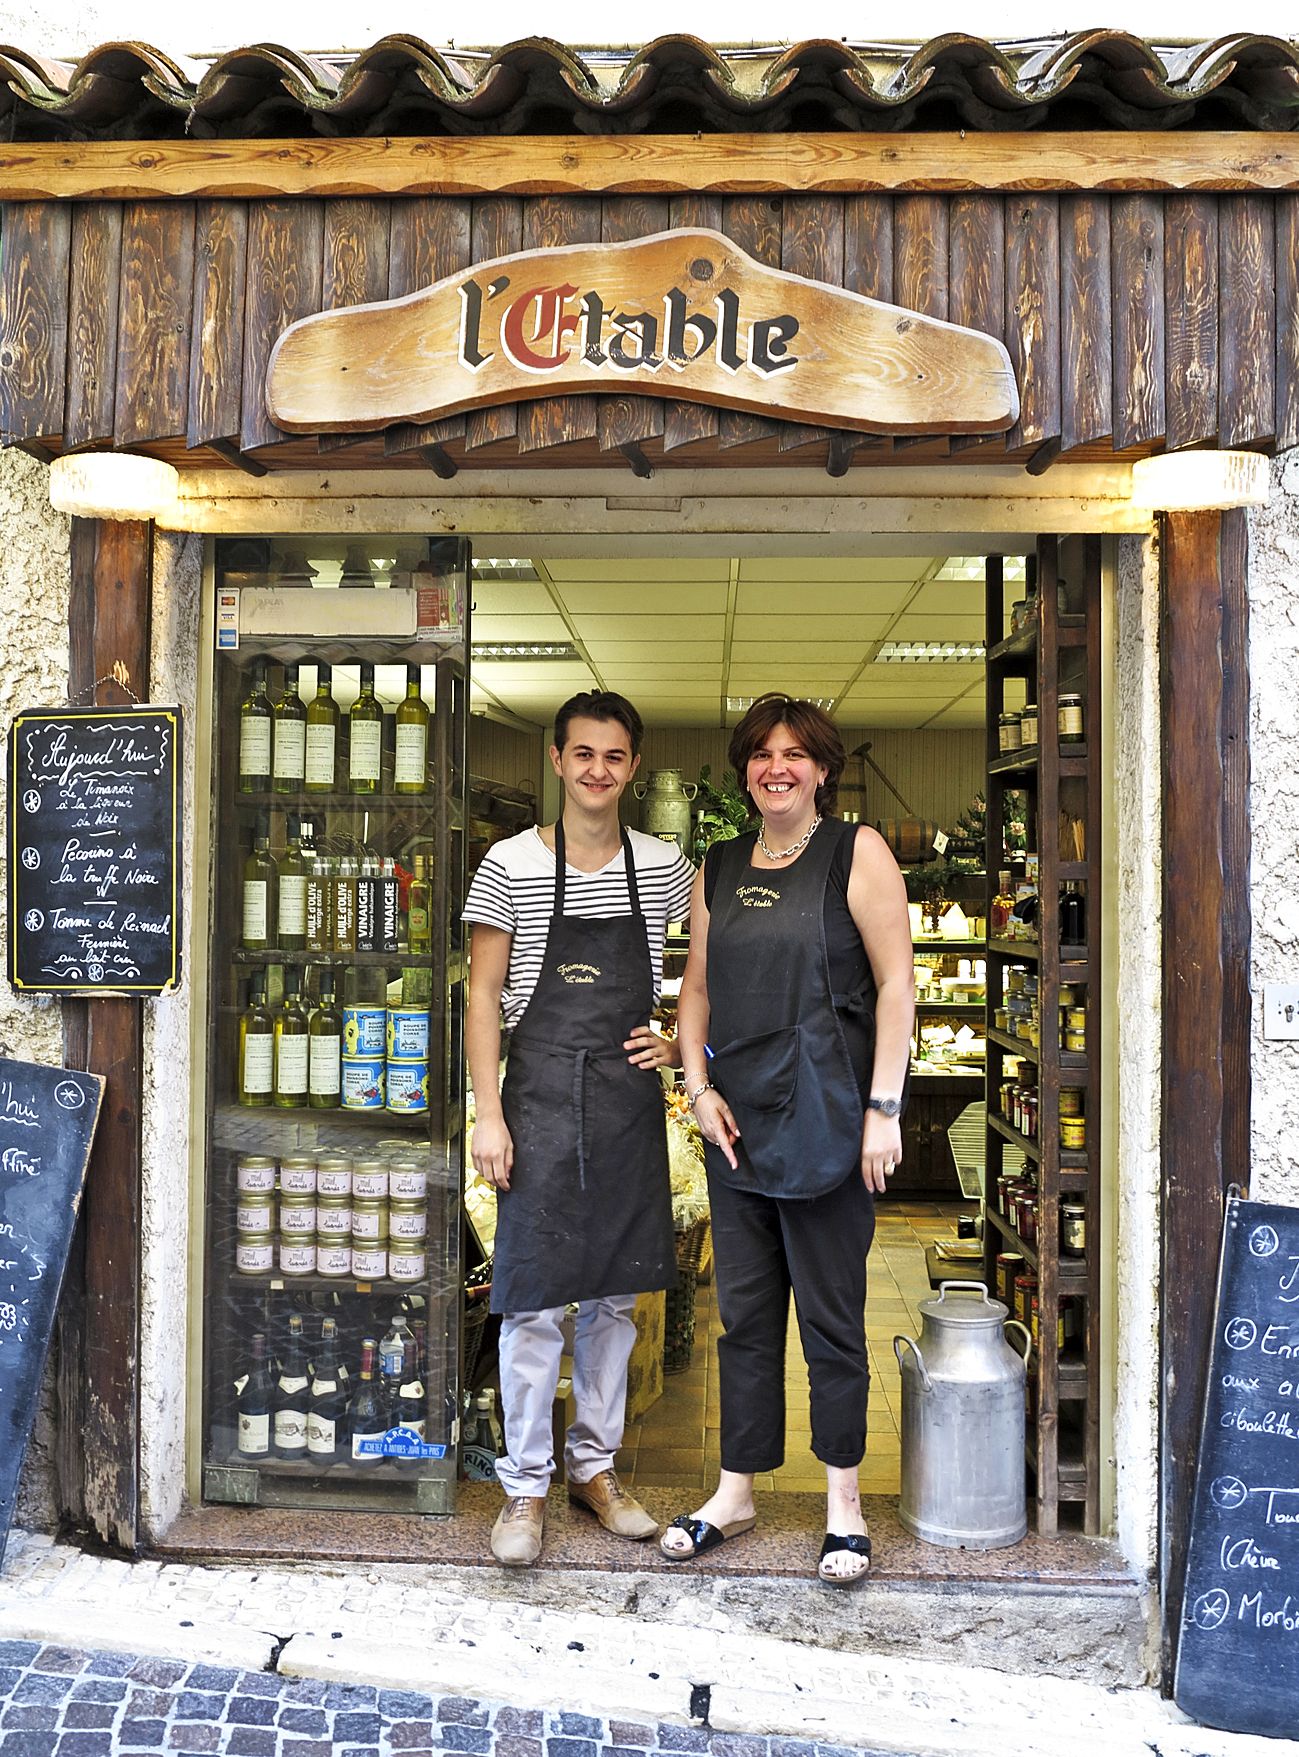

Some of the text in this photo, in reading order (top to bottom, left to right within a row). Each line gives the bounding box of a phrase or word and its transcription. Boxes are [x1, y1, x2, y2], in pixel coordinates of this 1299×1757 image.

[41, 732, 155, 786] Aujourd'hui
[71, 799, 87, 810] la
[72, 812, 91, 828] de
[61, 838, 137, 863] Pecorino à
[50, 864, 159, 897] la truffe Noire
[308, 882, 317, 913] d'OLIVE
[338, 882, 347, 913] d'OLIVE
[736, 886, 781, 900] Fromagerie
[98, 910, 115, 930] de
[358, 882, 368, 938] VINAIGRE
[384, 882, 394, 938] VINAIGRE
[308, 914, 317, 938] HUILE
[338, 914, 347, 938] HUILE
[54, 953, 77, 964] au
[79, 949, 111, 964] lait
[557, 963, 601, 976] Fromagerie
[1222, 1374, 1260, 1390] aux
